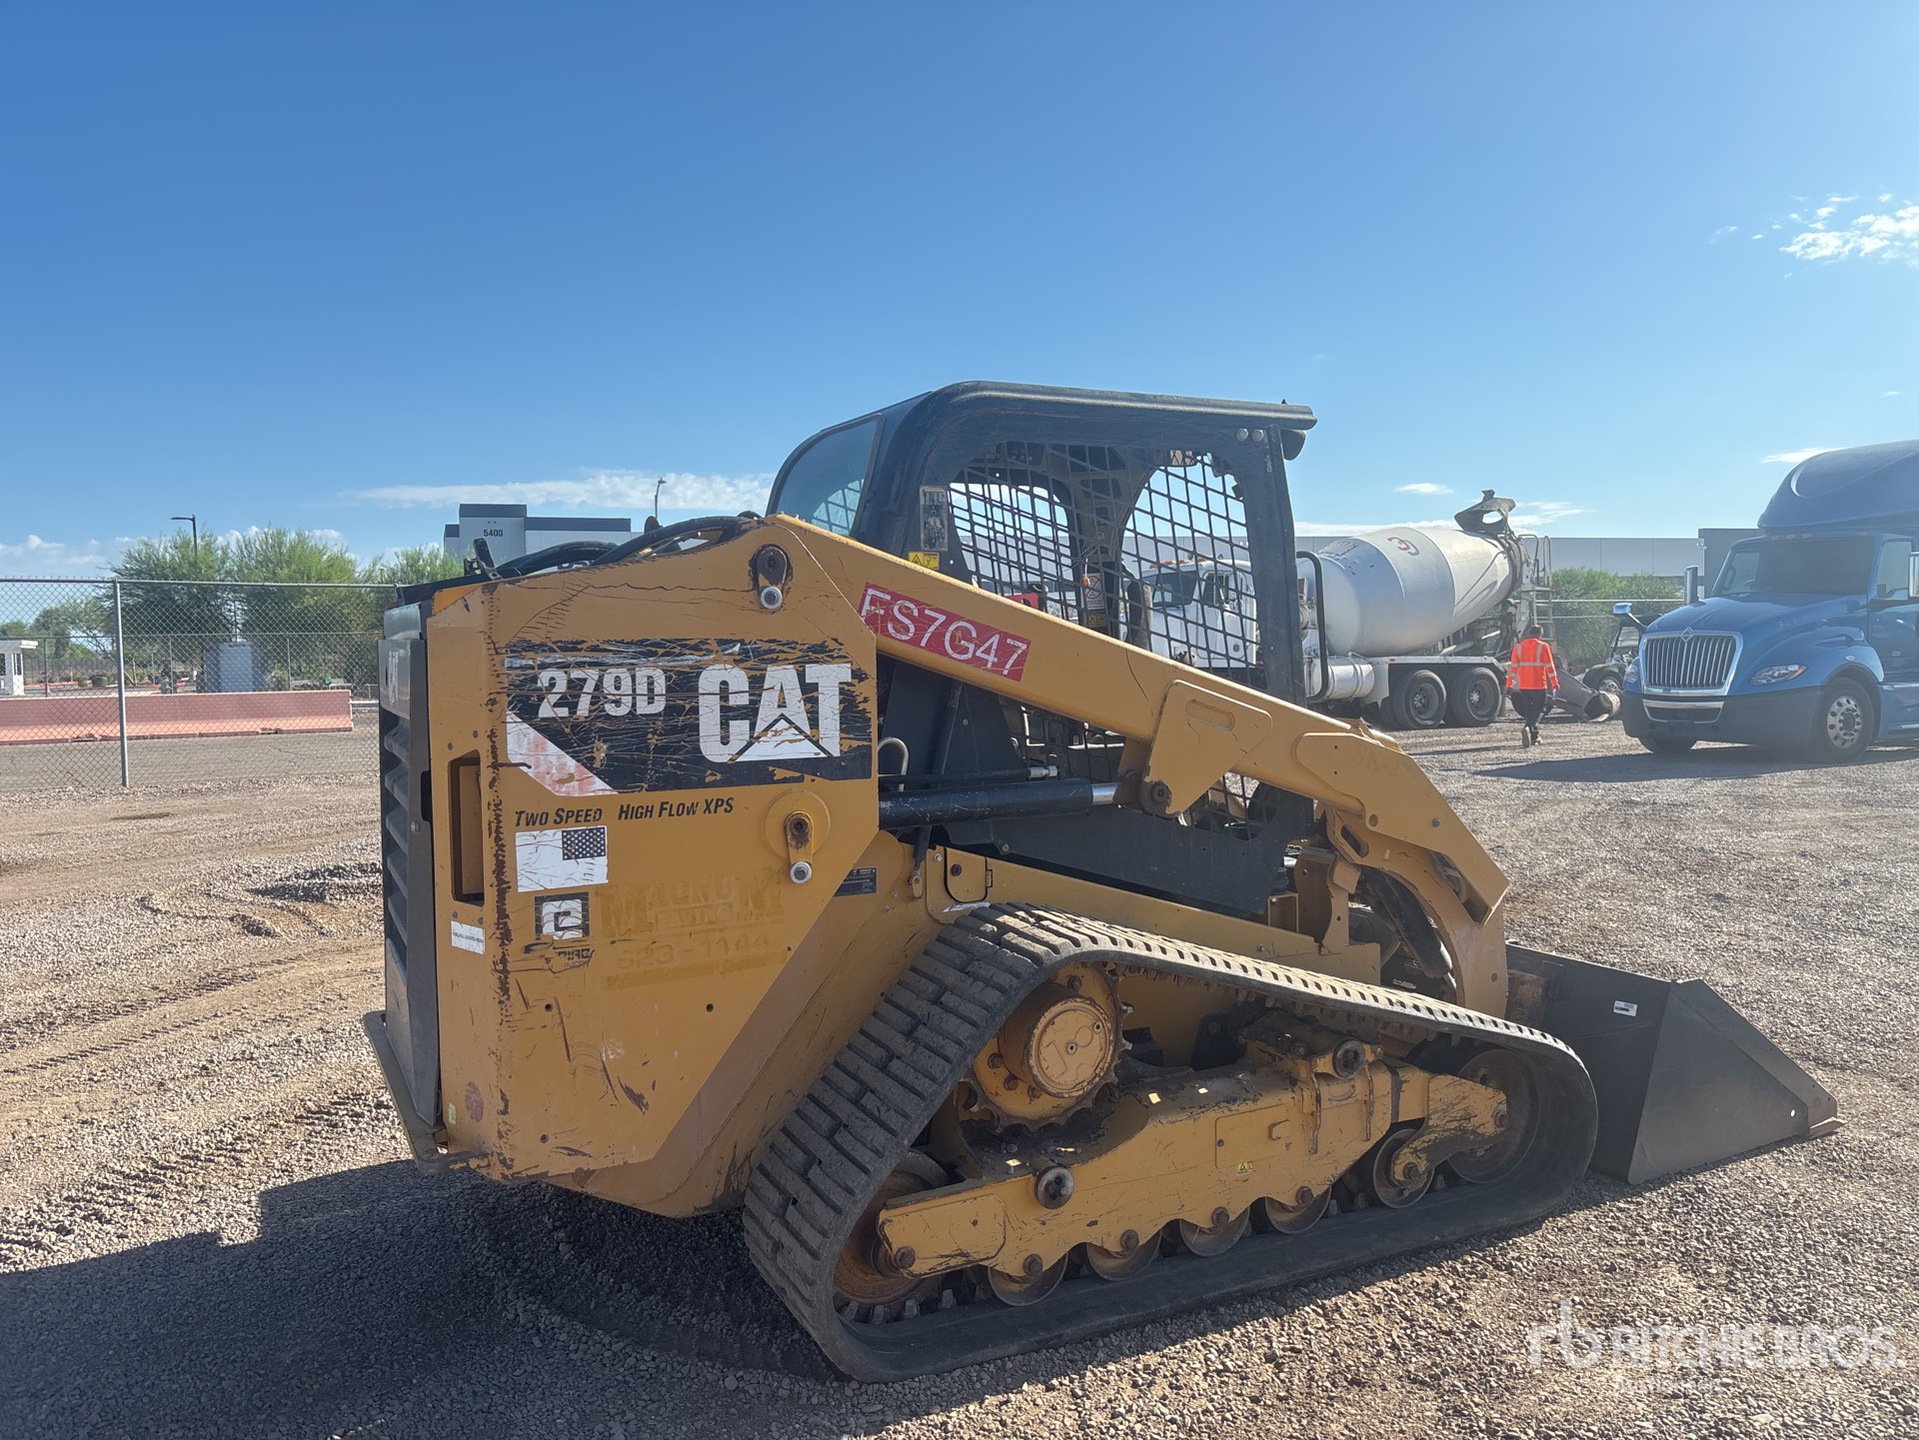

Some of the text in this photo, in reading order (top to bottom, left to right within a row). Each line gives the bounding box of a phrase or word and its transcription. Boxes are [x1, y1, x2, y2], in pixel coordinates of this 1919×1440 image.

[483, 529, 504, 538] 5400
[537, 663, 852, 763] 279D CAT
[702, 797, 735, 814] XPS
